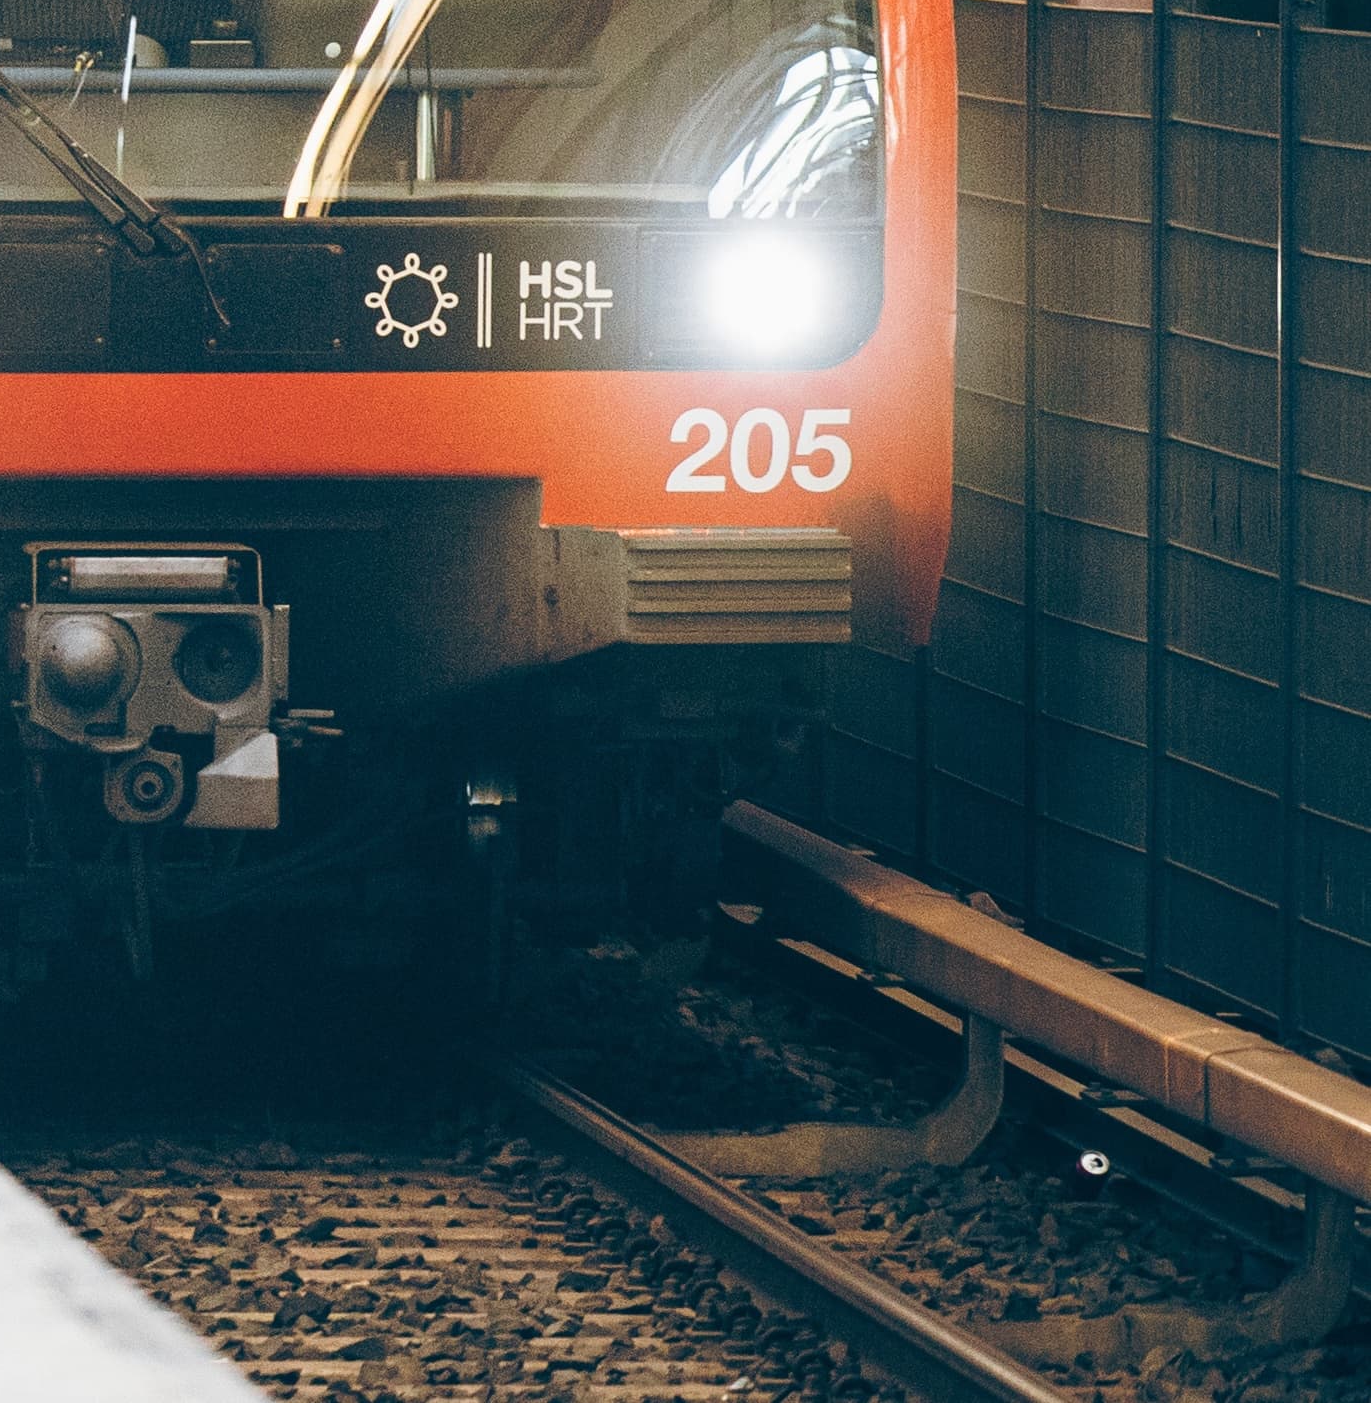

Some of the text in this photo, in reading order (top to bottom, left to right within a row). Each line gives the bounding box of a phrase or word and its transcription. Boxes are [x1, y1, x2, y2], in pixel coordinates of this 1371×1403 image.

[519, 260, 613, 300] HSL
[519, 301, 613, 341] HRT
[665, 407, 852, 493] 205
